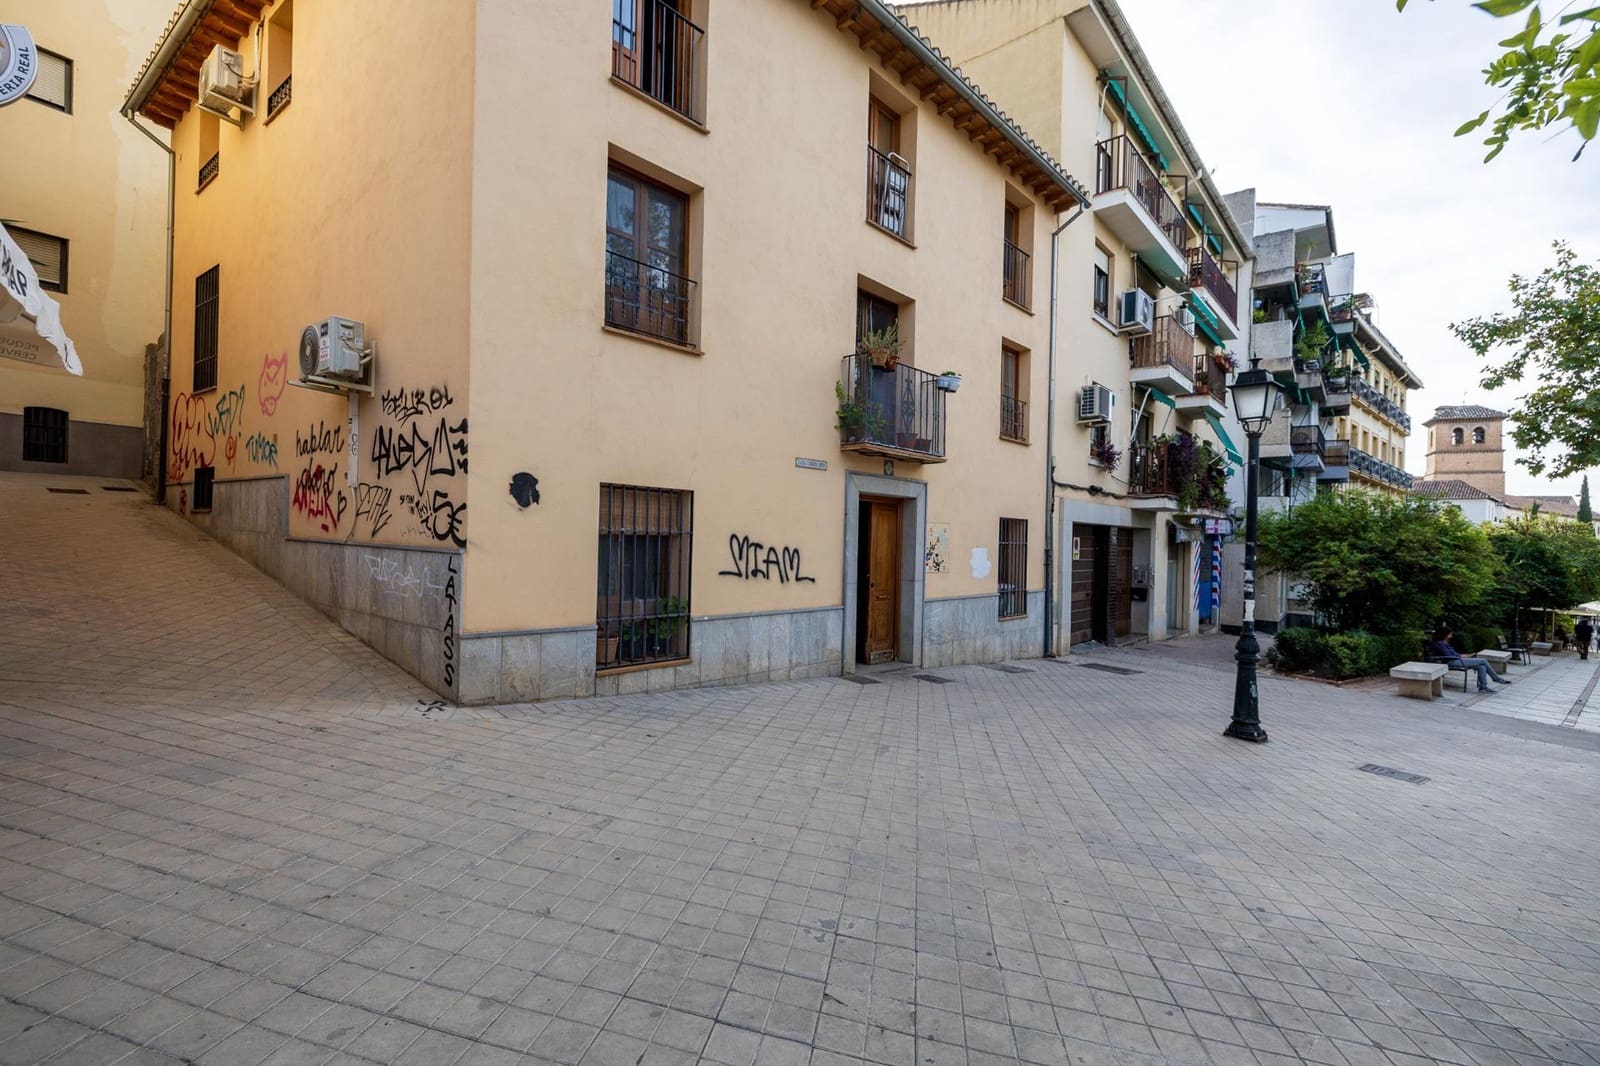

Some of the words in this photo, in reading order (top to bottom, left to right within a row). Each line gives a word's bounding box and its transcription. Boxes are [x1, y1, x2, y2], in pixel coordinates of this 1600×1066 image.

[17, 46, 30, 75] REAL
[245, 432, 279, 467] TUMOR
[296, 420, 345, 457] hablar
[718, 533, 816, 584] MIAM
